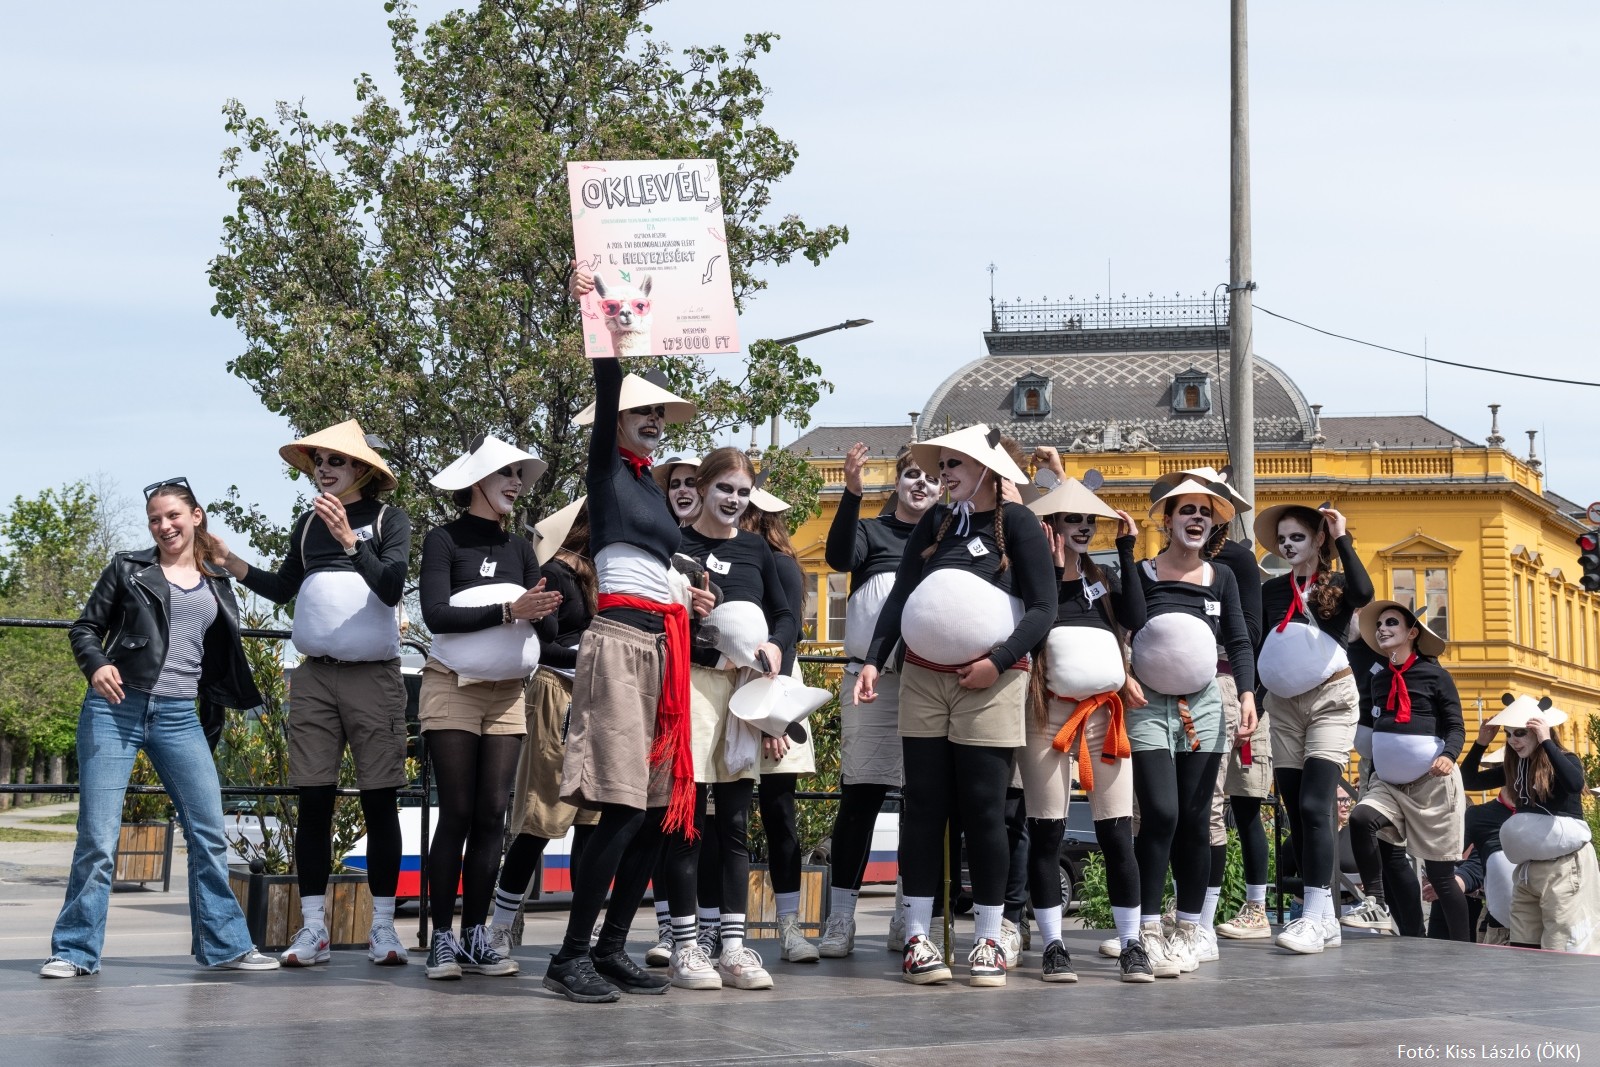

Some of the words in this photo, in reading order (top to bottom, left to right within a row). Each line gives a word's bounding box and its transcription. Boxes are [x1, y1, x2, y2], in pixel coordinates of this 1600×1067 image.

[581, 163, 709, 209] OKLEVÉL
[634, 240, 680, 248] BOLONDBALLAGÁSON
[681, 239, 695, 247] ELÉRT
[623, 248, 696, 265] HELYEZÉSÉRT
[682, 326, 707, 334] NYEREMÉNY
[715, 335, 730, 349] FT
[972, 544, 984, 553] 33
[713, 561, 724, 571] 33
[1090, 588, 1100, 597] 33
